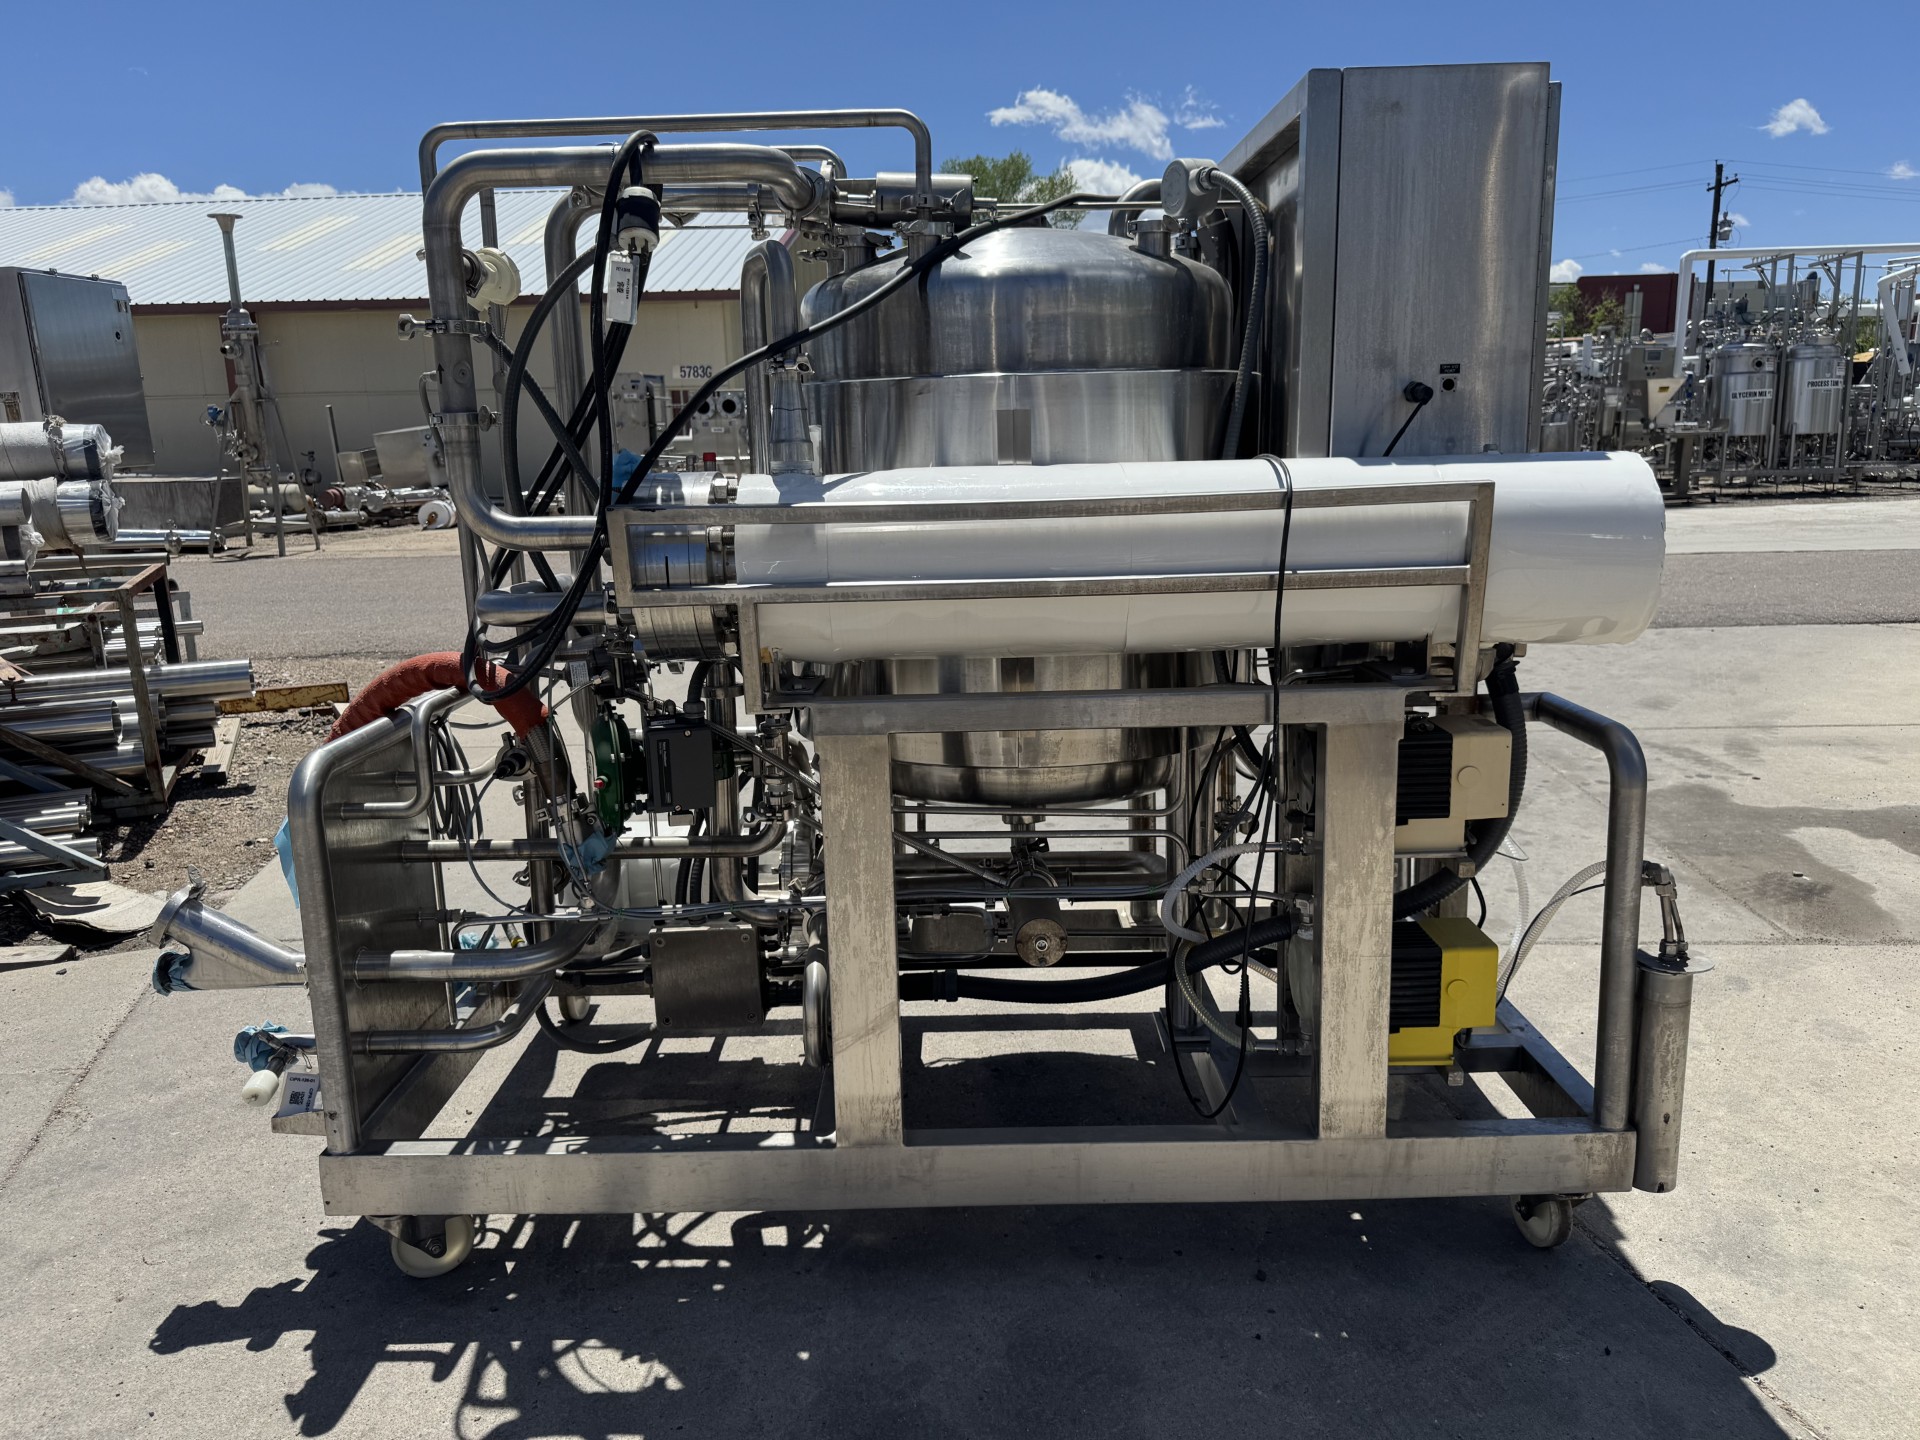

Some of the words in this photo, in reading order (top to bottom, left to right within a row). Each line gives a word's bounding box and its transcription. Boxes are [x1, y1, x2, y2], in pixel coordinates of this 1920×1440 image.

[680, 364, 712, 379] 5783G
[1806, 380, 1830, 388] PROCESS
[1731, 391, 1758, 399] GLYCERIN
